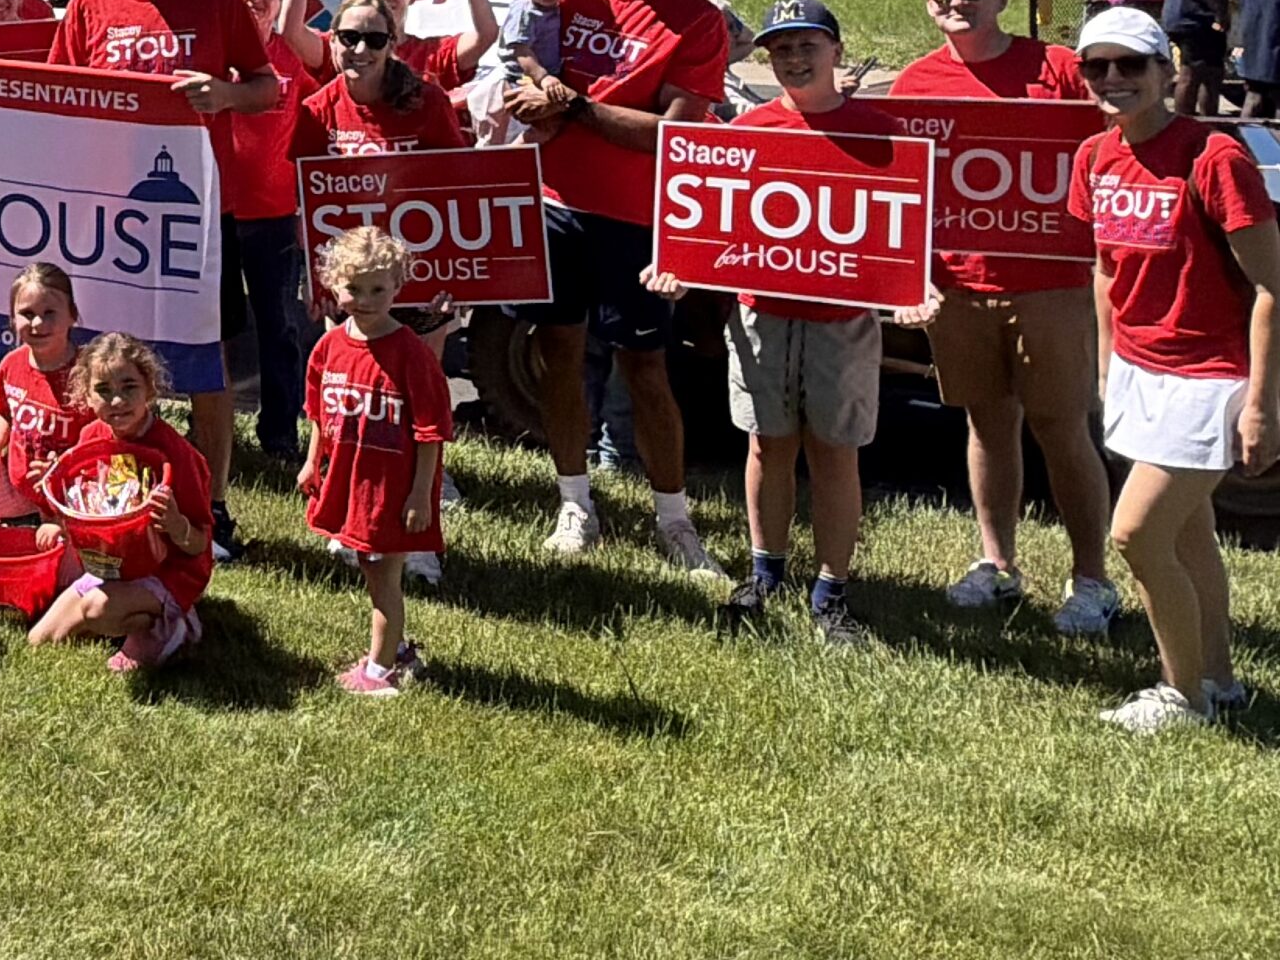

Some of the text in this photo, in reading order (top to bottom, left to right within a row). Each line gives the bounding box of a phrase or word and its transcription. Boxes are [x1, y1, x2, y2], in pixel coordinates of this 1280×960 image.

[106, 34, 197, 63] STOUT
[562, 26, 649, 63] STOUT
[328, 129, 366, 141] Stacey
[669, 136, 757, 172] Stacey
[309, 171, 388, 196] Stacey
[312, 196, 535, 253] STOUT
[664, 173, 921, 249] STOUT
[945, 206, 1060, 234] HOUSE
[742, 243, 859, 278] HOUSE
[7, 397, 74, 439] TOUT
[323, 387, 404, 425] STOUT
